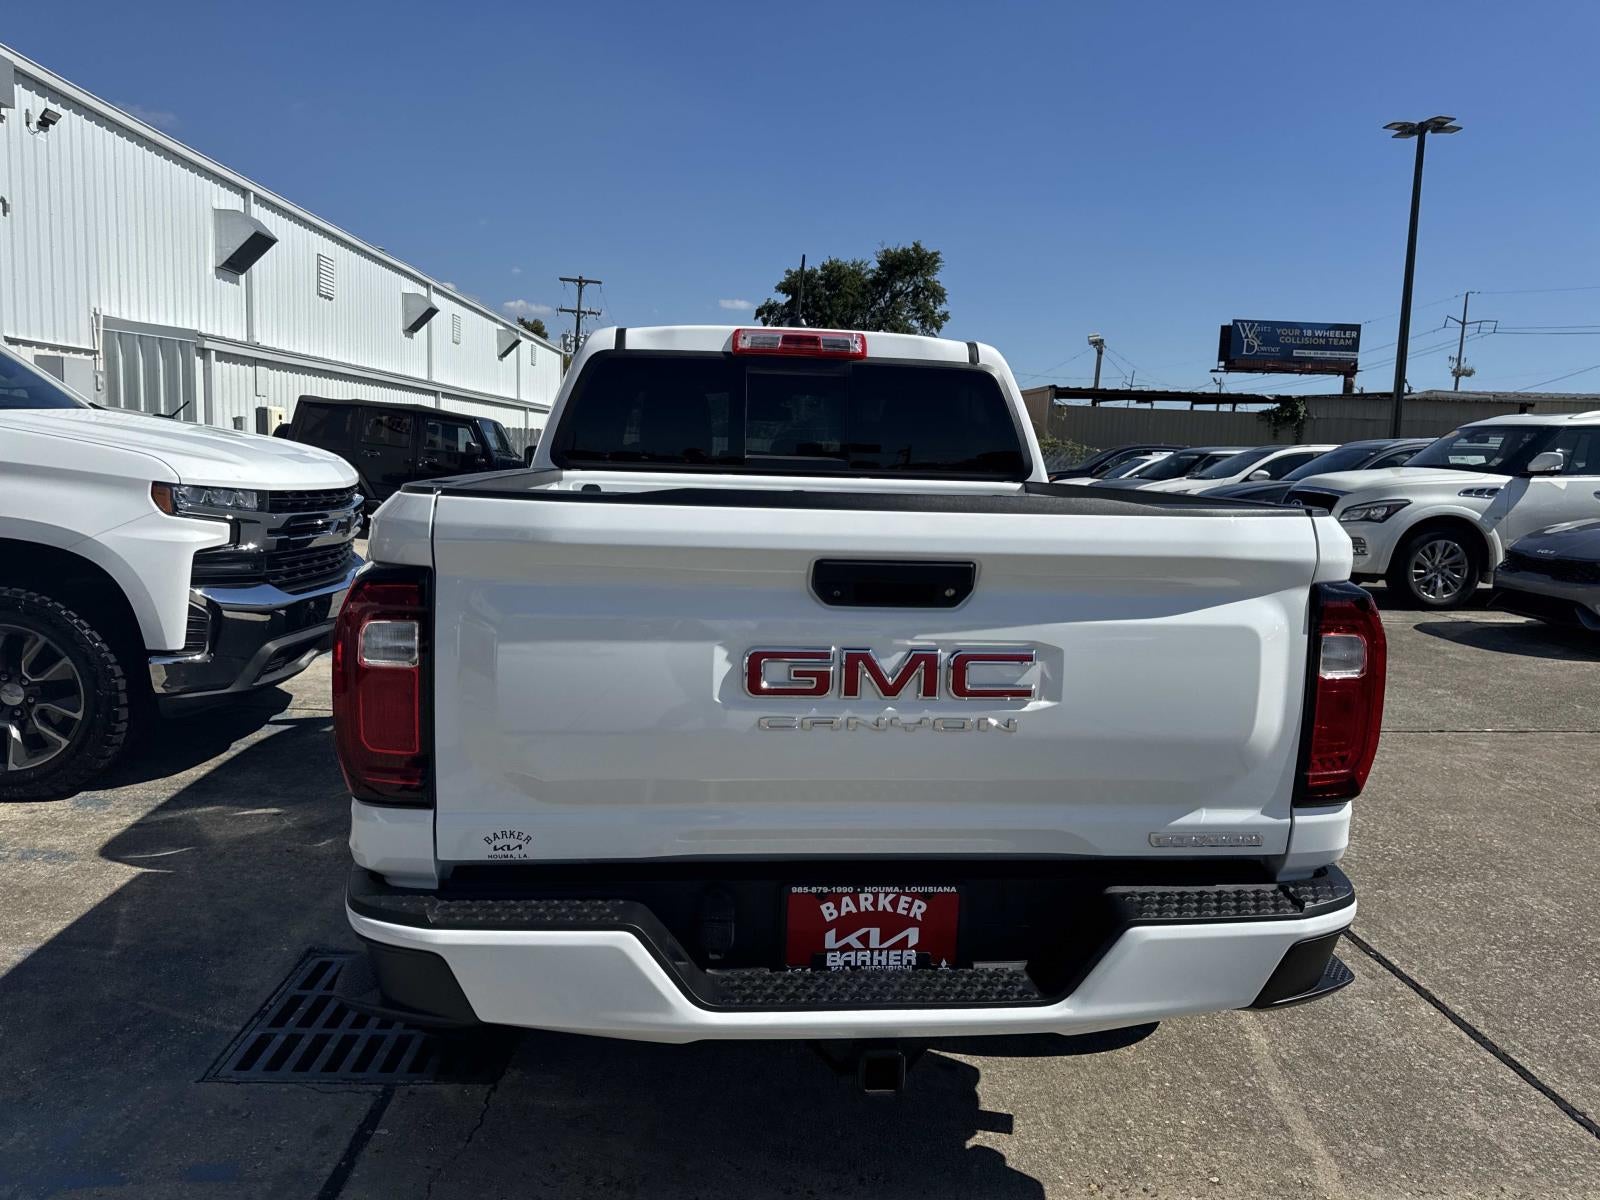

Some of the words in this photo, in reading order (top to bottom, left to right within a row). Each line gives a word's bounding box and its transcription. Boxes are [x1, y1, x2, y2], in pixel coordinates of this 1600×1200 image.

[1276, 328, 1300, 336] YOUR
[1303, 329, 1312, 337] 18
[1315, 329, 1358, 338] WHEELER
[1280, 336, 1326, 345] COLLISION
[1328, 338, 1353, 346] TEAM
[745, 646, 1037, 699] GMC
[758, 716, 1018, 732] CANYON
[483, 830, 532, 844] BARKER
[819, 893, 928, 922] BARKER
[826, 949, 917, 967] BARKER
